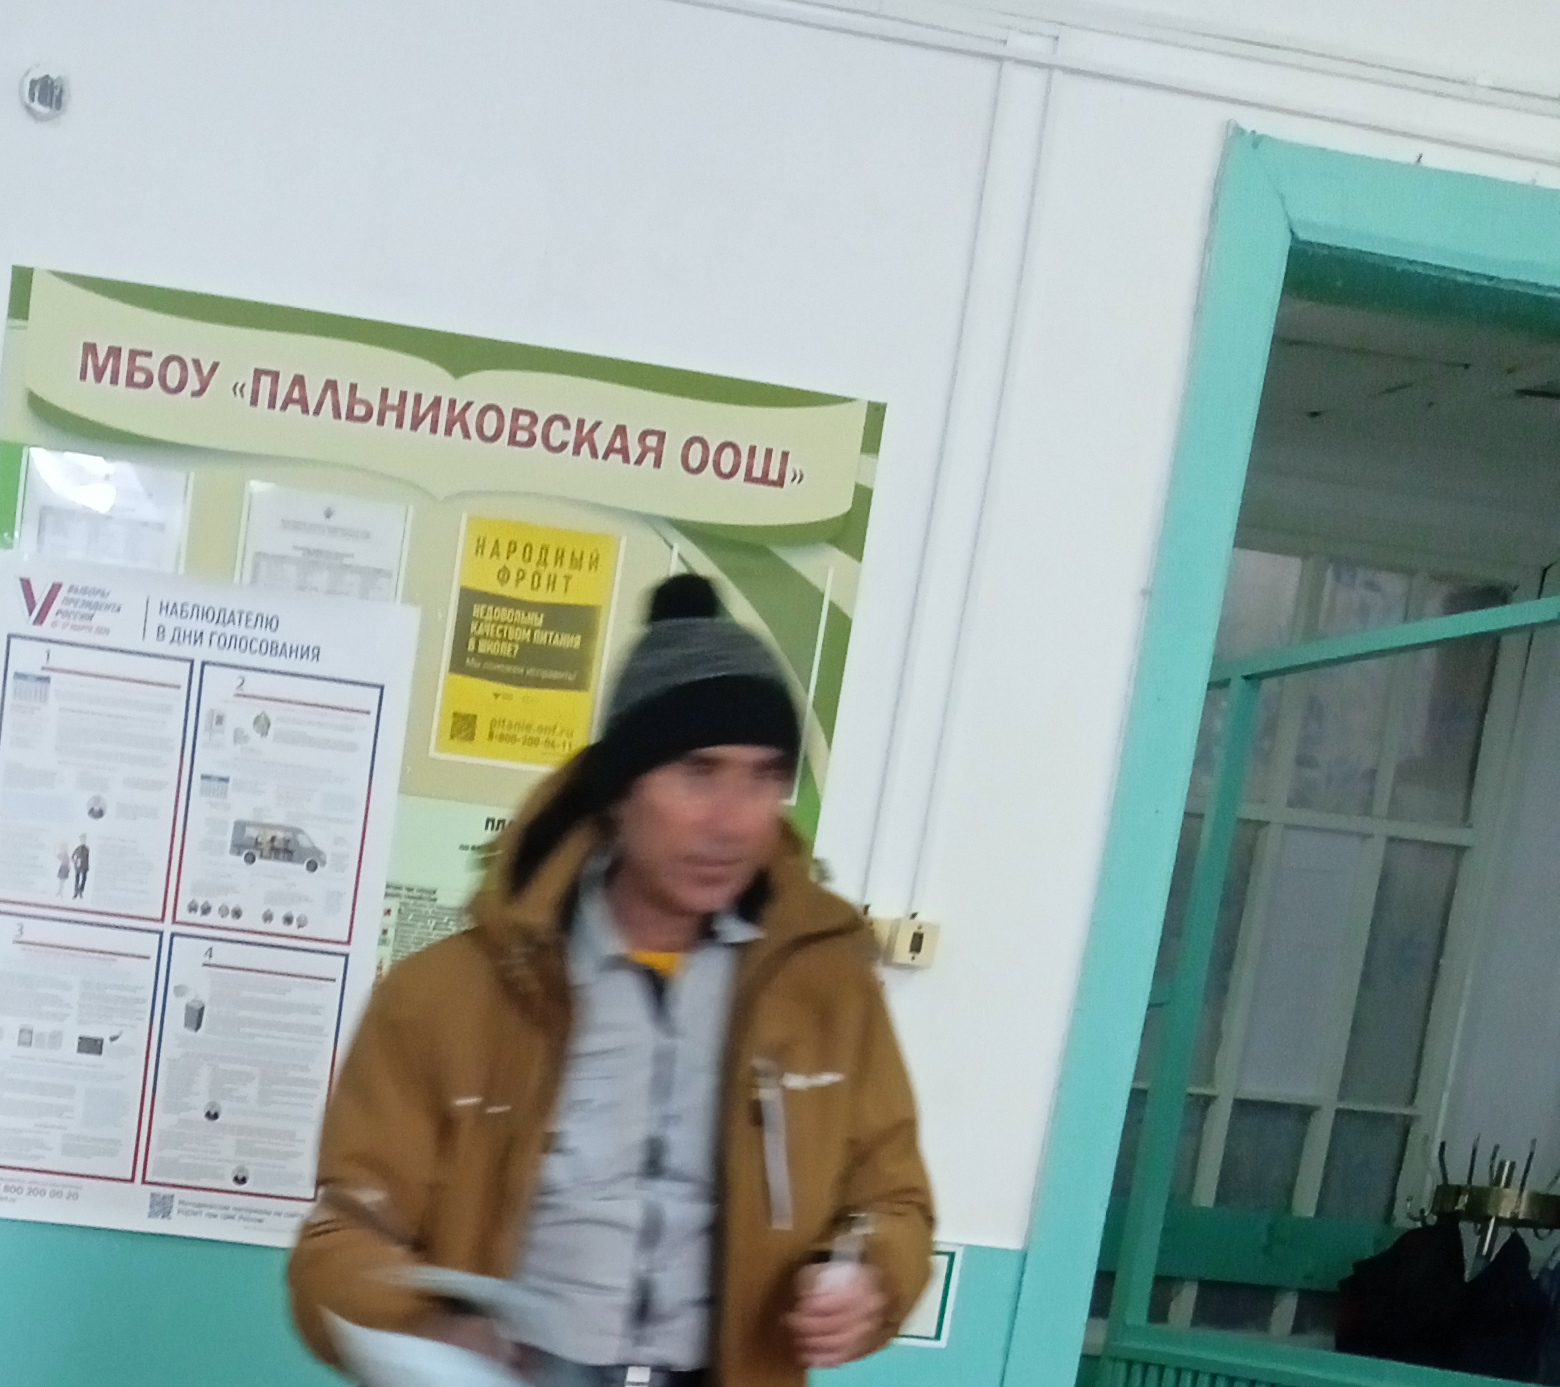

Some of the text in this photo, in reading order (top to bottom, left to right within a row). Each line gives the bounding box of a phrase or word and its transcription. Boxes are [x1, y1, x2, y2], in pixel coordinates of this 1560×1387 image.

[79, 341, 805, 489] МБОУ «ПАЛЬНИКОВСКАЯ ООШ»
[473, 536, 601, 573] НАРОДНЫЙ
[496, 564, 573, 595] ФРОНТ
[158, 599, 280, 633] НАБЛЮДАТЕЛЮ
[473, 603, 545, 627] НЕДОВОЛЬНЫ
[155, 625, 322, 663] В ДНИ ГОЛОСОВАНИЯ
[470, 621, 582, 650] КАЧЕСТВОМ ПИТАНИЯ
[236, 676, 246, 692] 2
[16, 922, 25, 938] 3
[203, 946, 214, 961] 4
